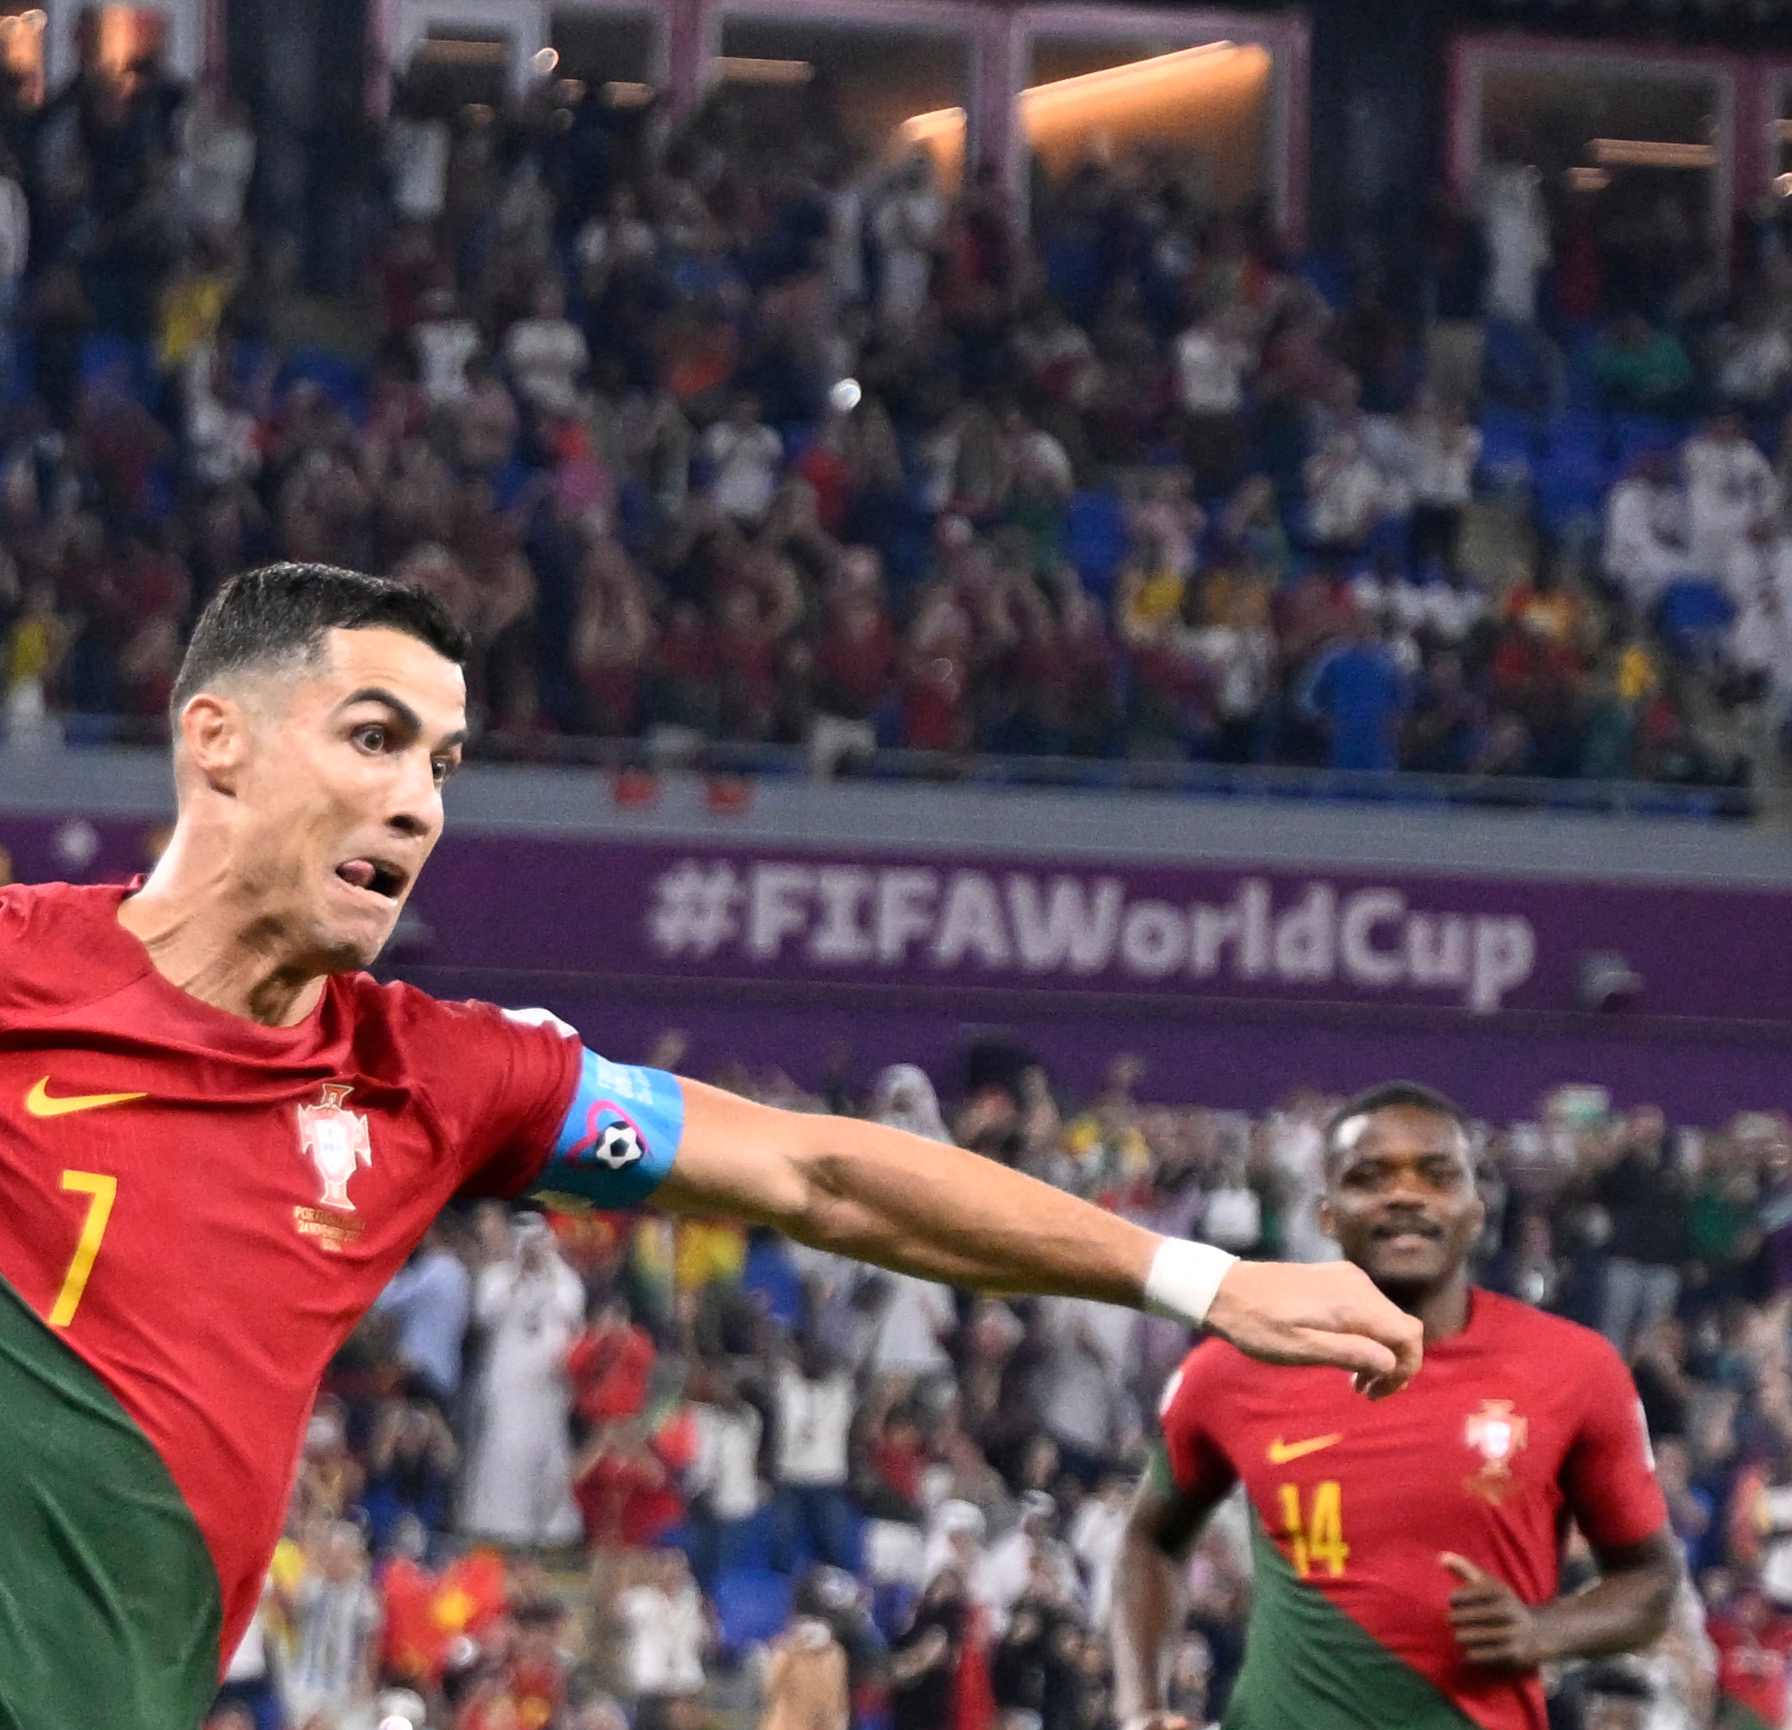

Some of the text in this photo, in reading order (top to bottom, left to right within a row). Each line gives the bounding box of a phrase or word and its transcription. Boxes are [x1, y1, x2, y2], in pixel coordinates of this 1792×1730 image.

[652, 859, 1535, 1012] #FIFAWorldCup
[48, 1169, 118, 1327] 7
[1278, 1481, 1350, 1579] 14
